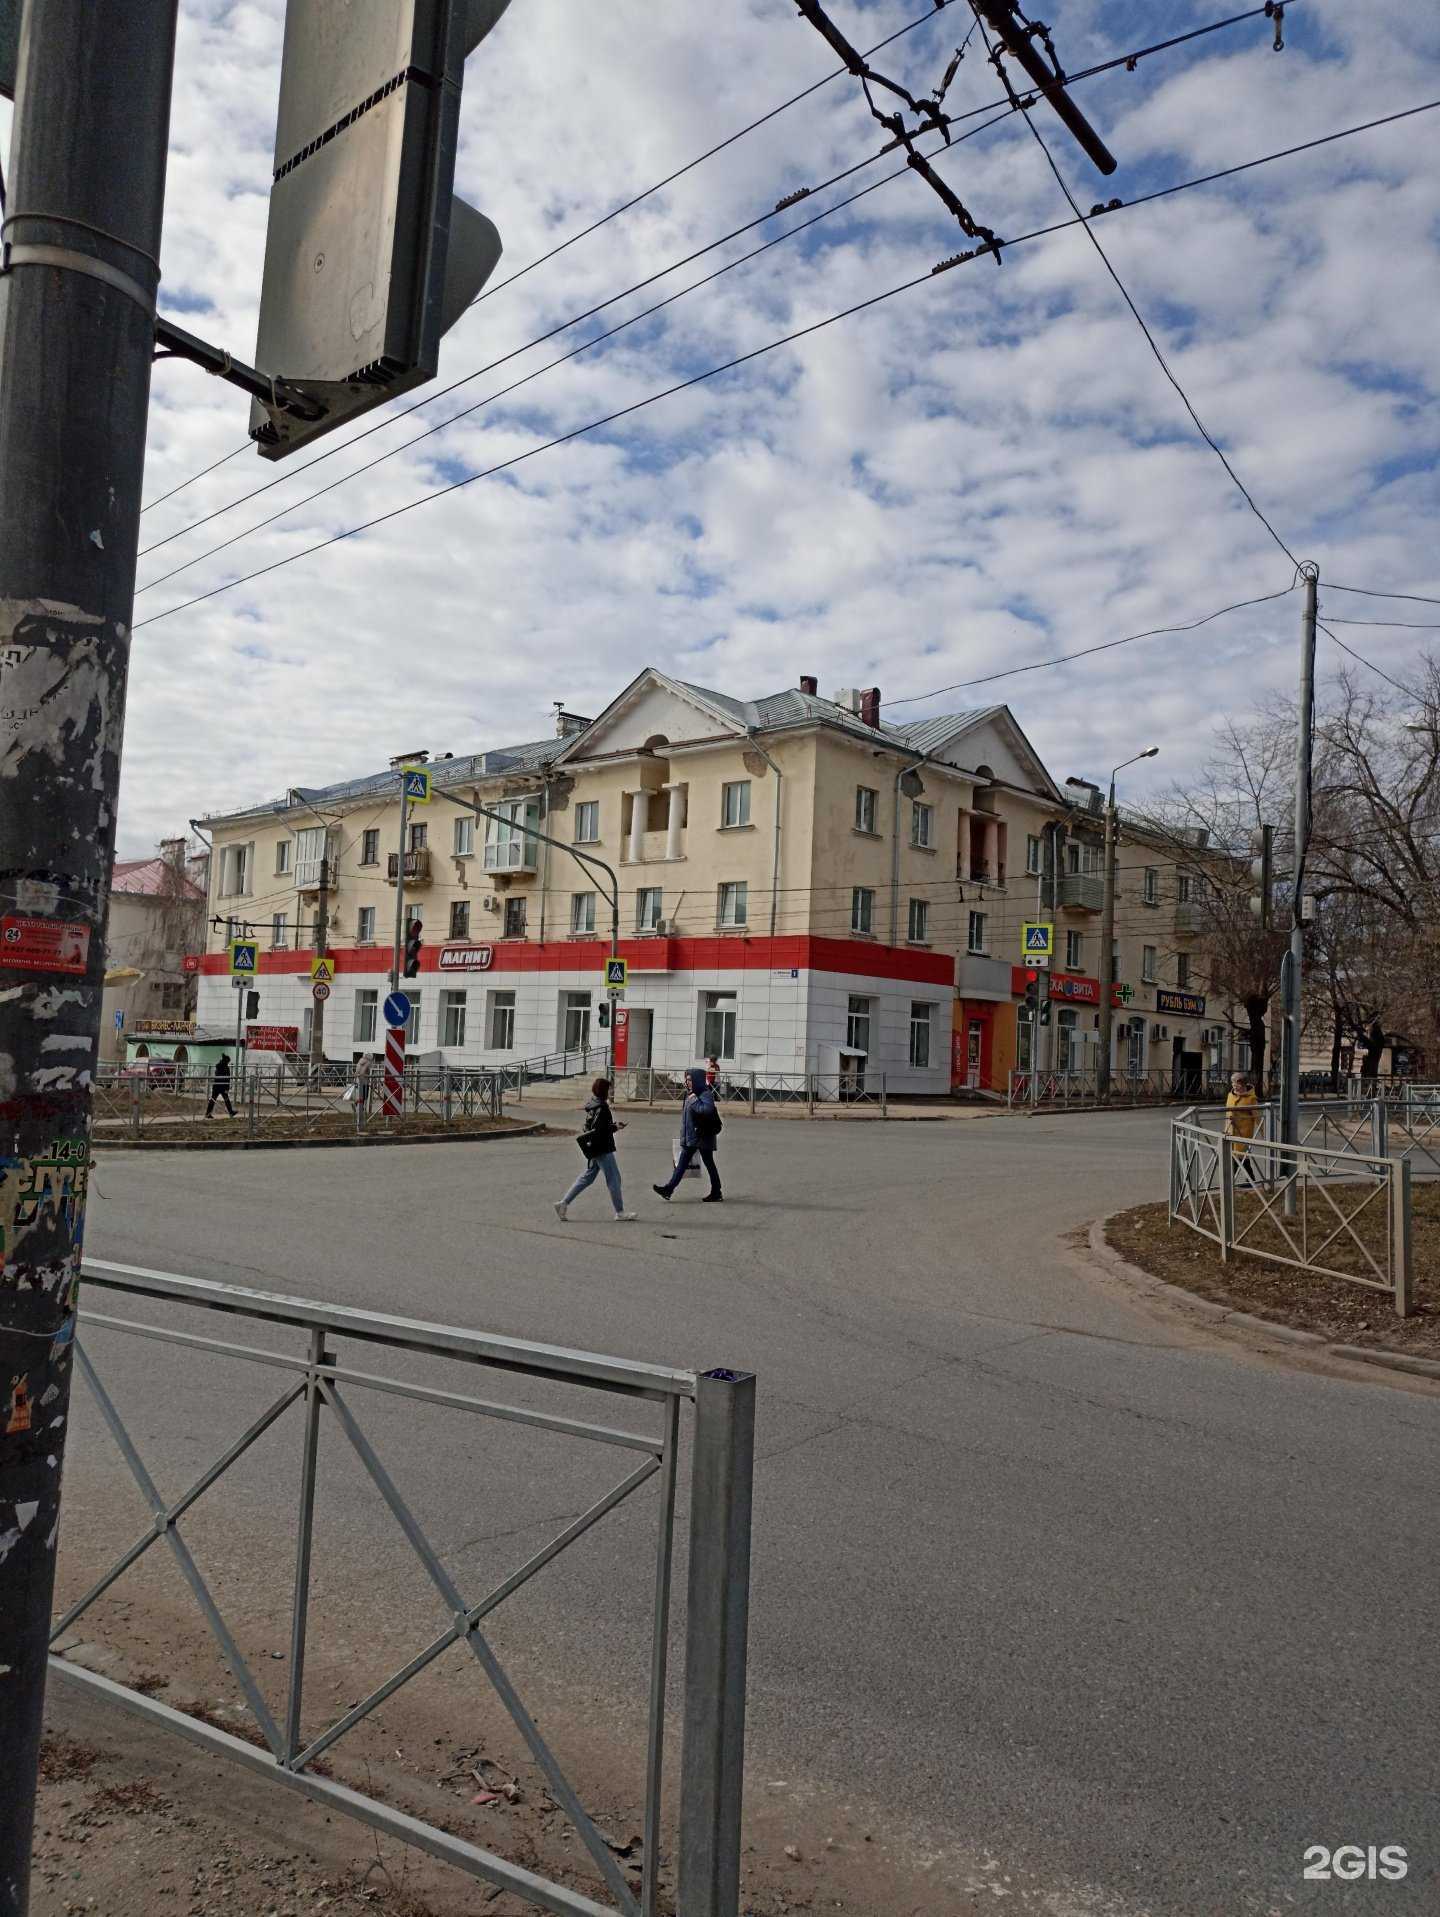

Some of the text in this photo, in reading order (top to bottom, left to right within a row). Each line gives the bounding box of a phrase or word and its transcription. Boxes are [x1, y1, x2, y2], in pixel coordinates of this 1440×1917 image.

[441, 950, 489, 965] МАГНИТ
[1073, 983, 1093, 997] ВИТА
[1160, 994, 1183, 1009] РУБЛЬ
